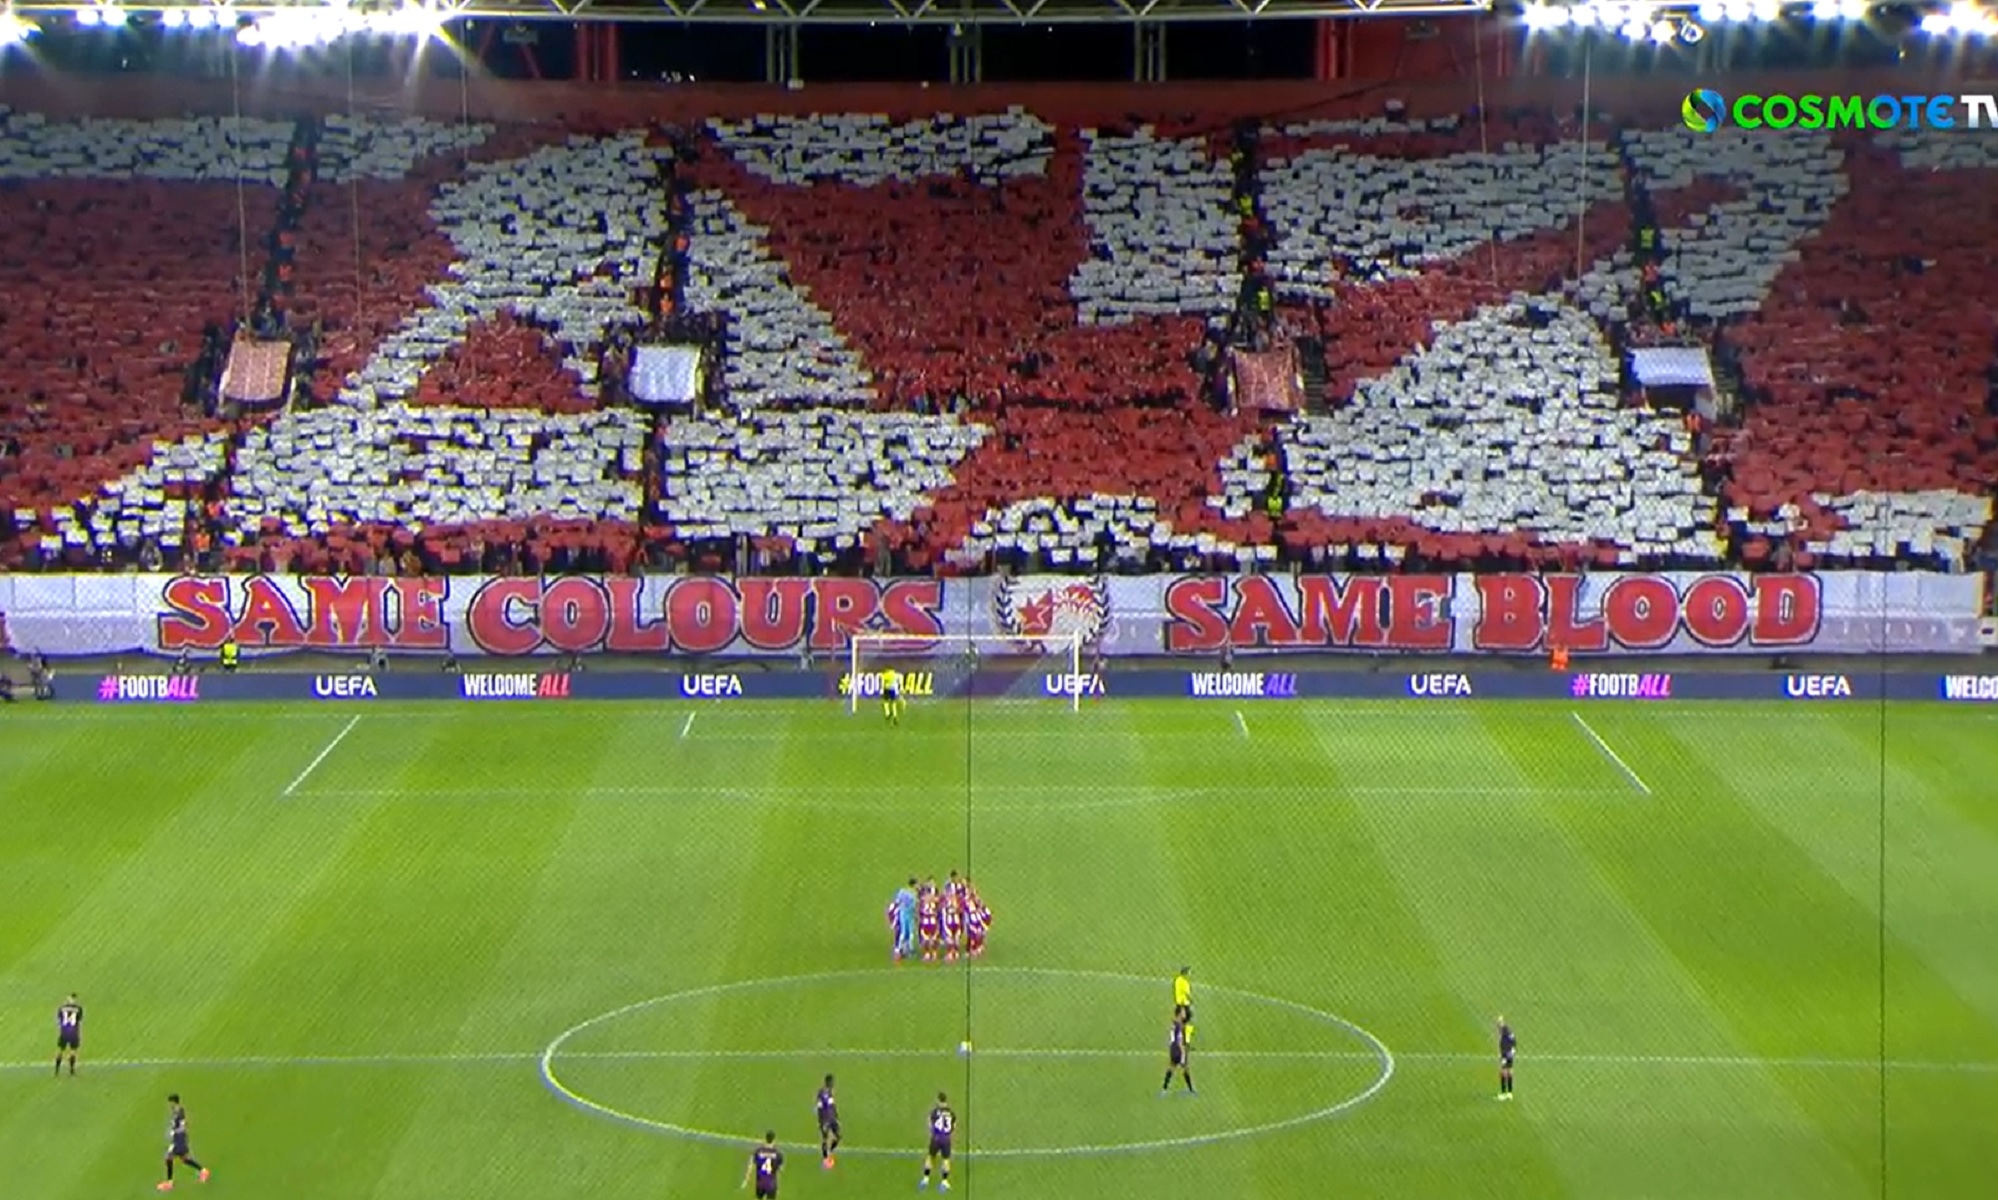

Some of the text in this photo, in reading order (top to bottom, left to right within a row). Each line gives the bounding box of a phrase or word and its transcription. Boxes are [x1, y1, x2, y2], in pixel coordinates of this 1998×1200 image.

[158, 574, 944, 654] SAME COLOURS
[1165, 573, 1821, 651] SAME BLOOD
[100, 675, 198, 698] #FOOTBALL
[315, 674, 377, 697] UEFA
[464, 673, 569, 697] WELCOME ALL
[683, 674, 743, 696] UEFA
[1046, 674, 1105, 695] UEFA
[1191, 673, 1297, 697] WELCOME ALL
[1411, 673, 1471, 696] UEFA
[1572, 673, 1671, 696] #FOOTBALL
[1788, 674, 1850, 696] UEFA
[62, 1011, 77, 1026] 14
[934, 1115, 952, 1133] 43
[761, 1158, 772, 1175] 4
